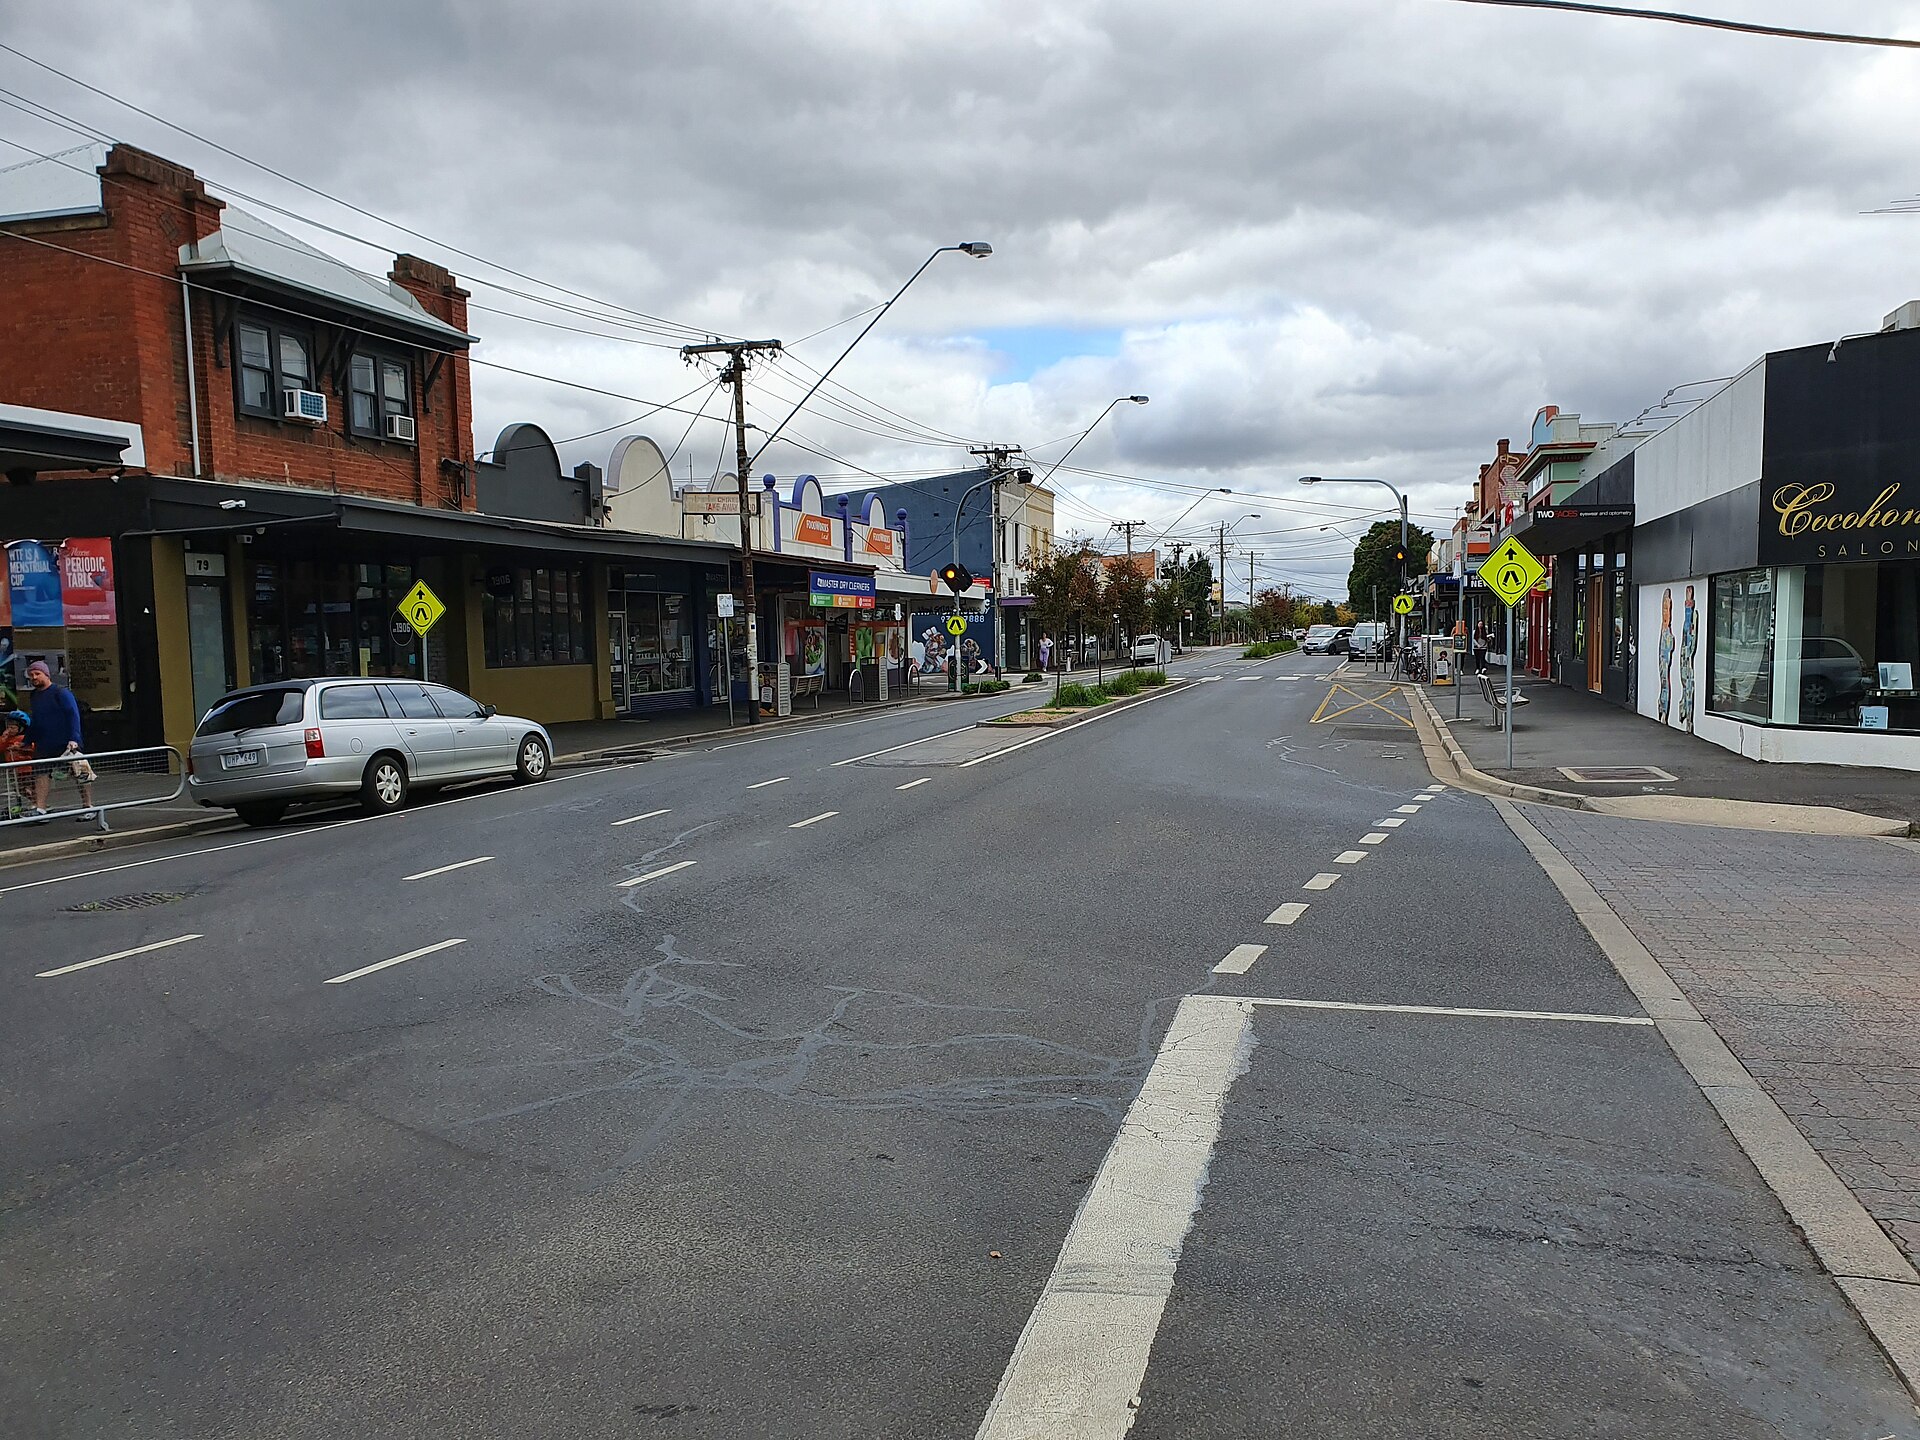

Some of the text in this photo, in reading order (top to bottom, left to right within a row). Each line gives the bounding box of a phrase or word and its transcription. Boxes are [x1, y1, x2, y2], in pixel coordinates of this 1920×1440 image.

[9, 549, 23, 561] WTF
[25, 548, 32, 560] IS
[34, 549, 39, 560] A
[1818, 540, 1918, 557] SALON
[10, 560, 51, 573] MENSTRUAL
[65, 556, 106, 572] PERIODIC
[197, 560, 209, 570] 79
[11, 574, 25, 587] CUP
[67, 572, 94, 588] TABLE
[821, 579, 870, 591] MASTER DRY CLEANERS
[396, 622, 411, 633] 1906
